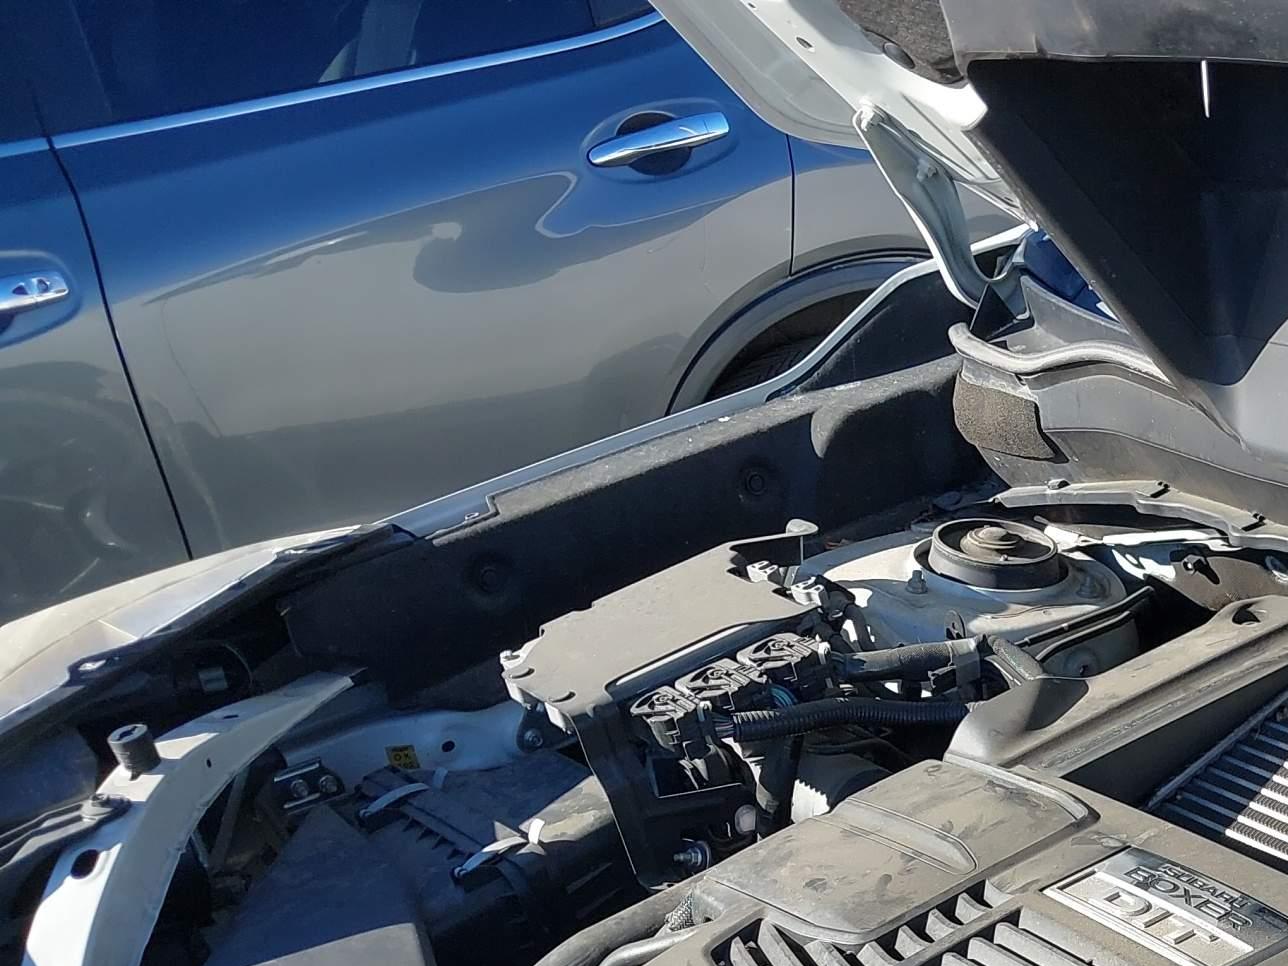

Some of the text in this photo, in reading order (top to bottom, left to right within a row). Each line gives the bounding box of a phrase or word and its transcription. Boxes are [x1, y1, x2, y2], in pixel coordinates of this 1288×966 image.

[1124, 866, 1253, 931] BOXER
[1160, 864, 1254, 908] SUBARU
[1104, 888, 1220, 945] DIT
